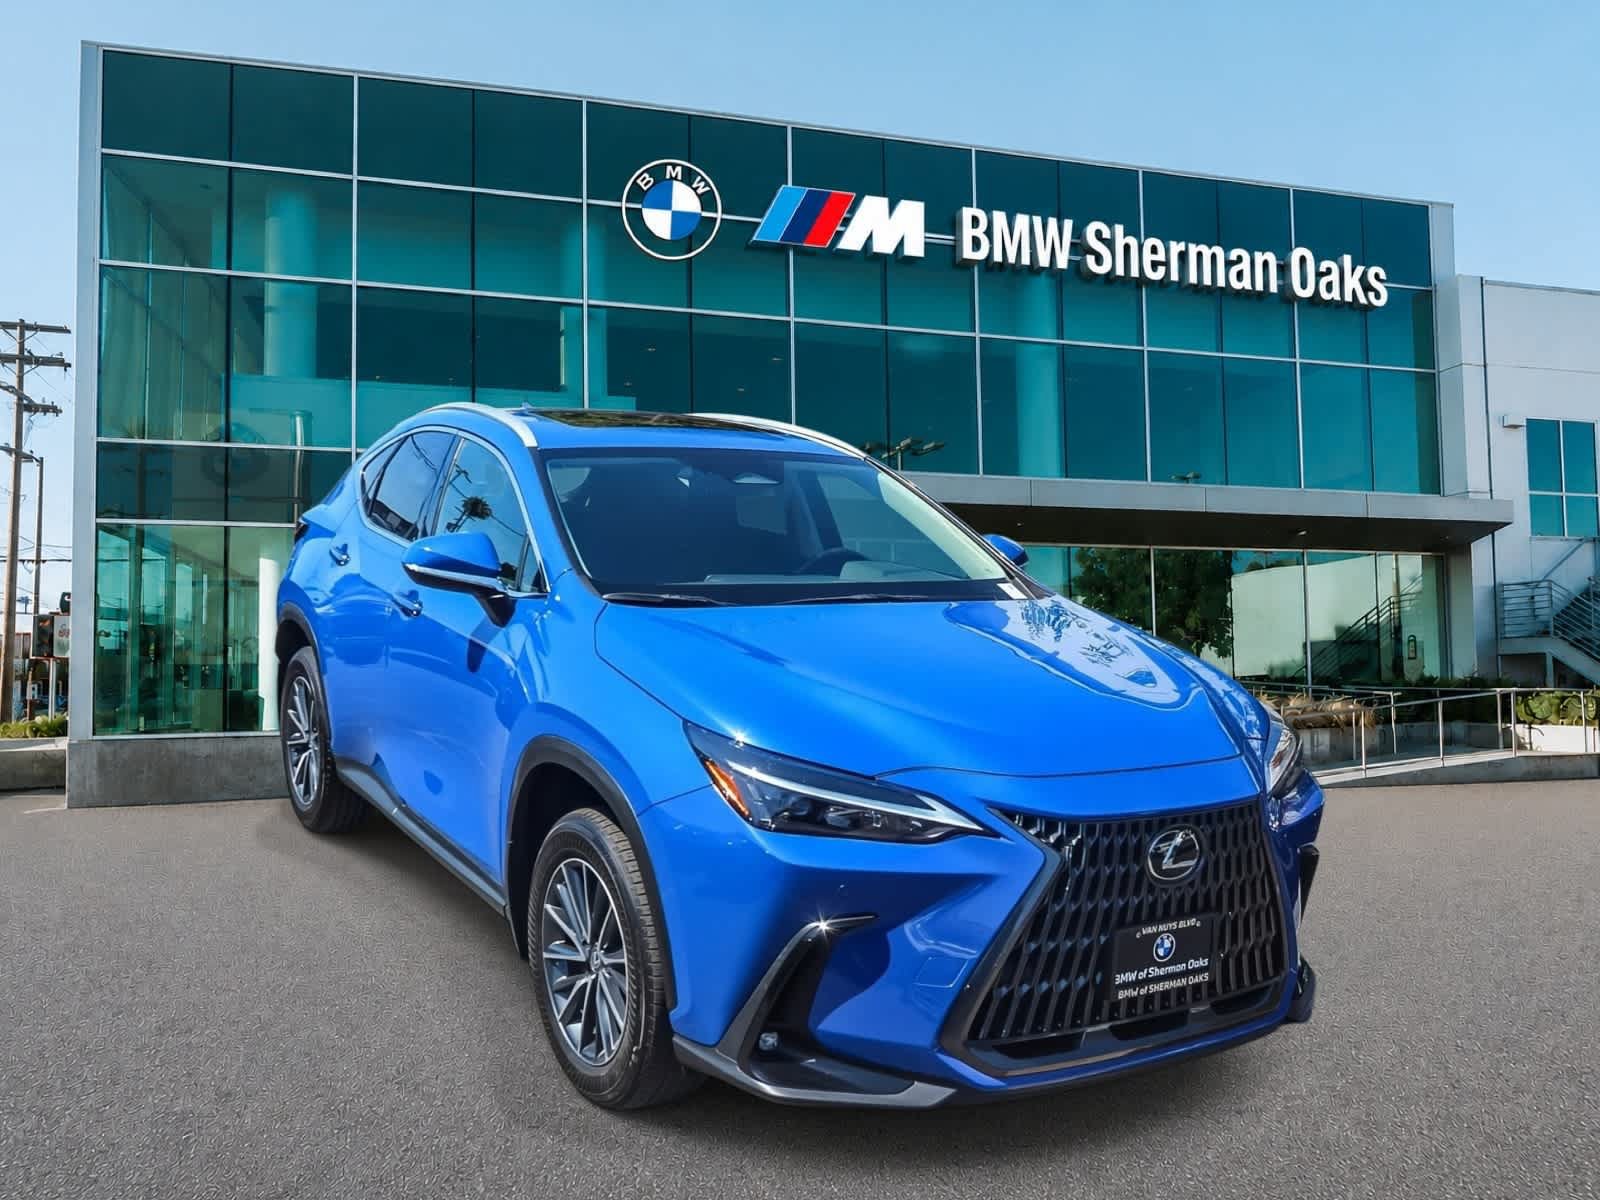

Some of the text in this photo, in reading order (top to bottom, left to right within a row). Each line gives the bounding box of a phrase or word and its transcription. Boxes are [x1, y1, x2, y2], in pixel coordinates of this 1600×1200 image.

[636, 164, 711, 194] BMW
[959, 206, 1389, 308] BMW Sherman Oaks
[1138, 968, 1148, 980] of
[1148, 962, 1187, 978] Sherman
[1187, 957, 1209, 970] Oaks
[1118, 972, 1209, 1000] BMW of SHERMAN OAKS
